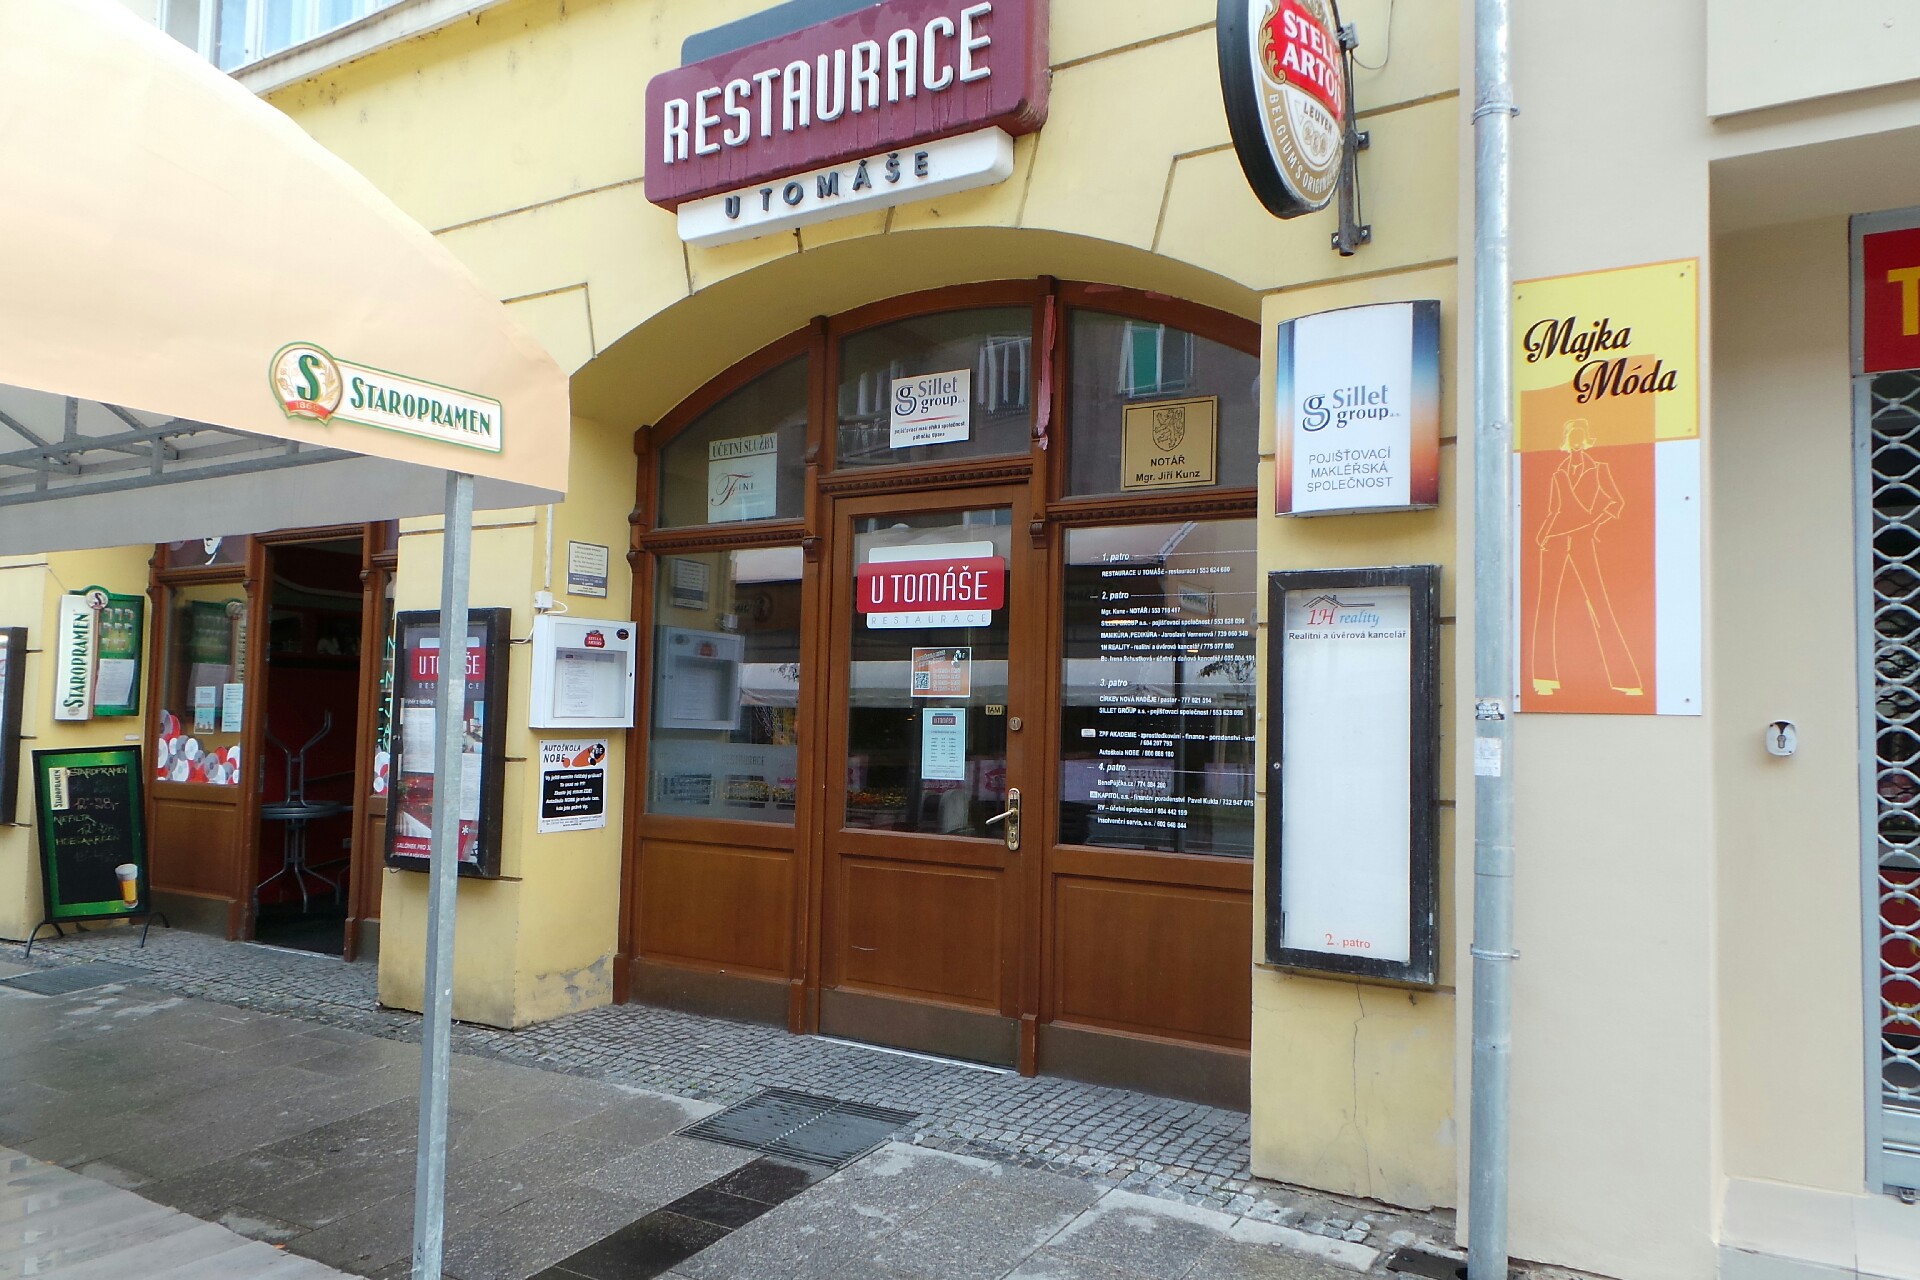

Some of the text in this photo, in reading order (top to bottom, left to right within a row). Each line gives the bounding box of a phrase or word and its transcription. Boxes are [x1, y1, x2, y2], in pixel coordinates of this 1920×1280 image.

[663, 1, 993, 164] RESTAURACE
[1282, 42, 1342, 112] ARTOIS
[1303, 102, 1333, 133] LEUVEN
[724, 151, 929, 219] U TOMÁŠE
[1523, 315, 1632, 364] Majka
[918, 376, 957, 397] Sillet
[1573, 358, 1679, 404] Móda
[921, 395, 957, 413] group
[1332, 384, 1389, 409] Sillet
[350, 376, 491, 436] STAROPRAMEN
[1336, 406, 1389, 428] group
[744, 434, 776, 453] SLUŽBY
[1151, 455, 1185, 467] NOTÁŘ
[1308, 446, 1391, 465] POJIŠŤOVACÍ
[1136, 470, 1200, 483] Mgr. Jiří Kunz
[1311, 461, 1388, 478] MAKLÉŘSKÁ
[1306, 476, 1394, 493] SPOLEČNOST
[1110, 552, 1130, 562] patro
[871, 565, 988, 604] U TOMÁŠE
[1102, 591, 1129, 601] 2. patro
[871, 613, 987, 625] RESTAURACE
[1339, 610, 1380, 628] reality
[1289, 631, 1320, 640] Realitní
[1367, 630, 1407, 639] kancelář
[63, 613, 89, 708] STAROPRAMEN
[1107, 679, 1128, 688] patro
[543, 744, 581, 752] AUTOŠKOLA
[544, 753, 566, 763] NOBE
[1106, 763, 1126, 773] patro
[1325, 933, 1371, 949] 2. patro
